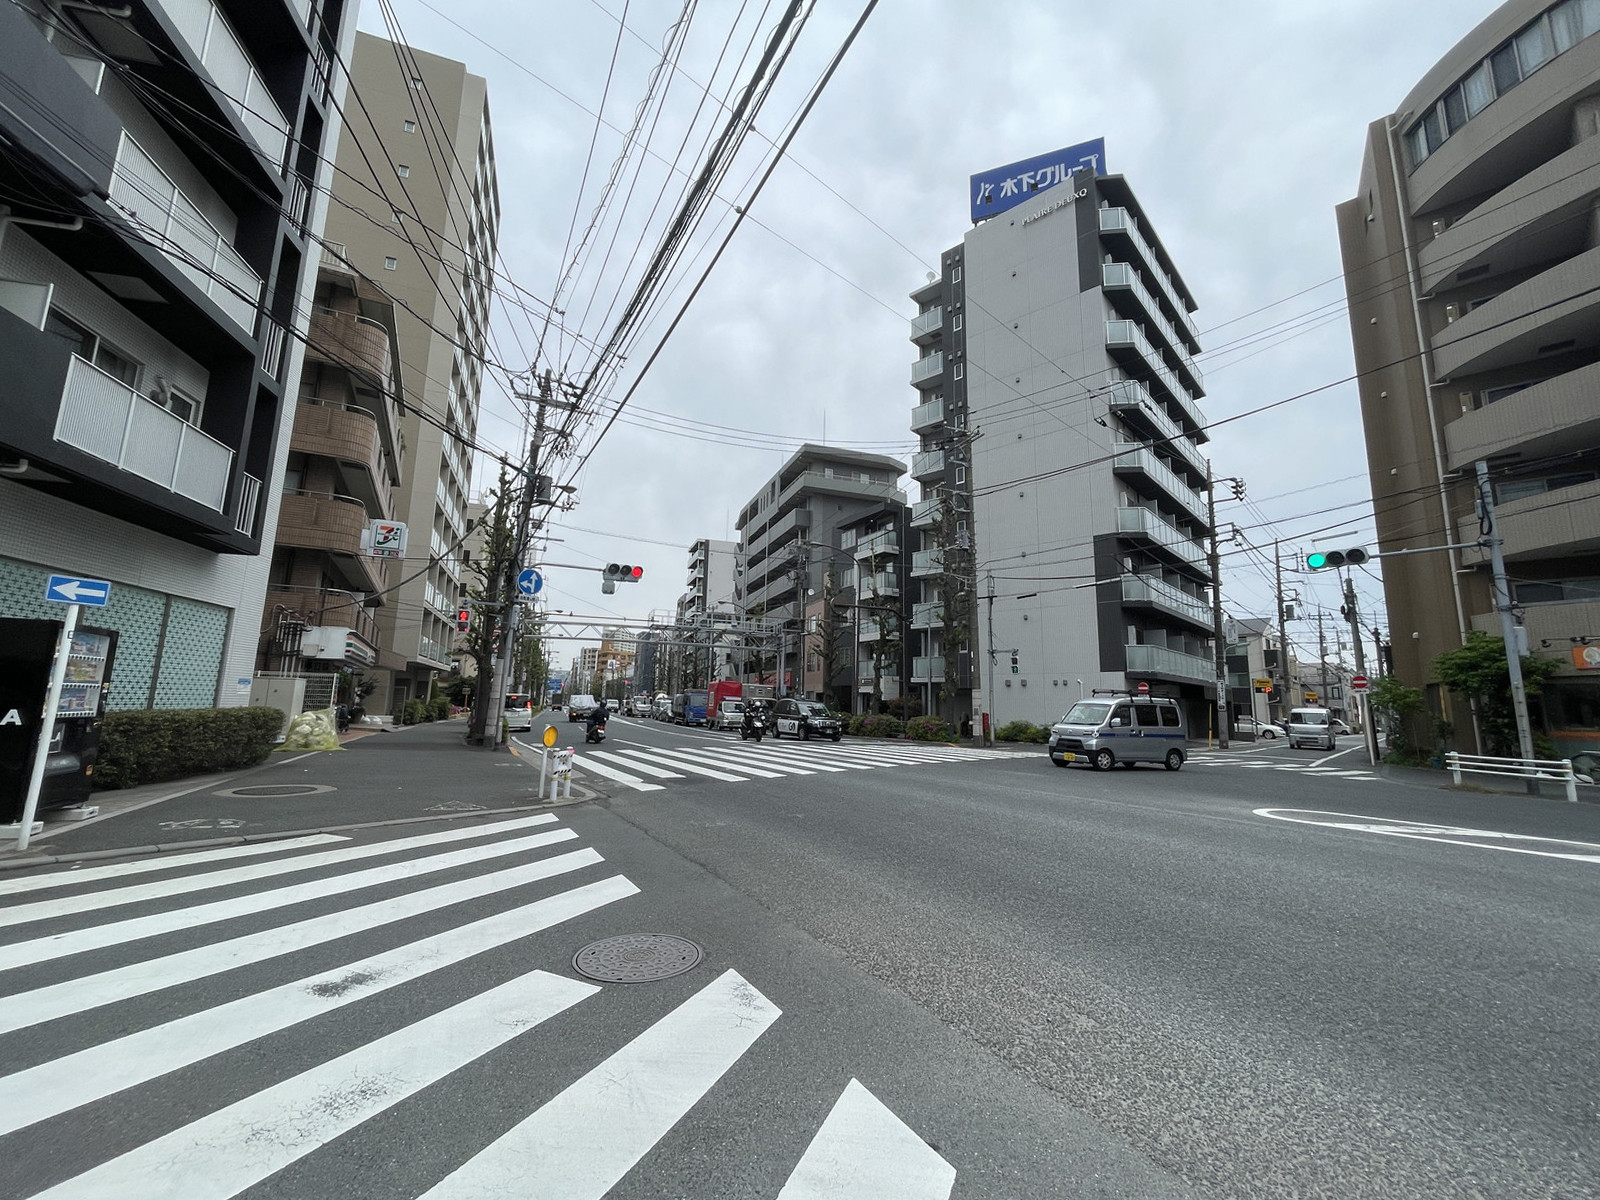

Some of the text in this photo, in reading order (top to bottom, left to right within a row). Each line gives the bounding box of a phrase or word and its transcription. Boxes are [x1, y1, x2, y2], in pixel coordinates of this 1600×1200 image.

[1000, 153, 1099, 199] 木下グループ
[1021, 205, 1053, 226] PLAIRE
[0, 708, 22, 726] A
